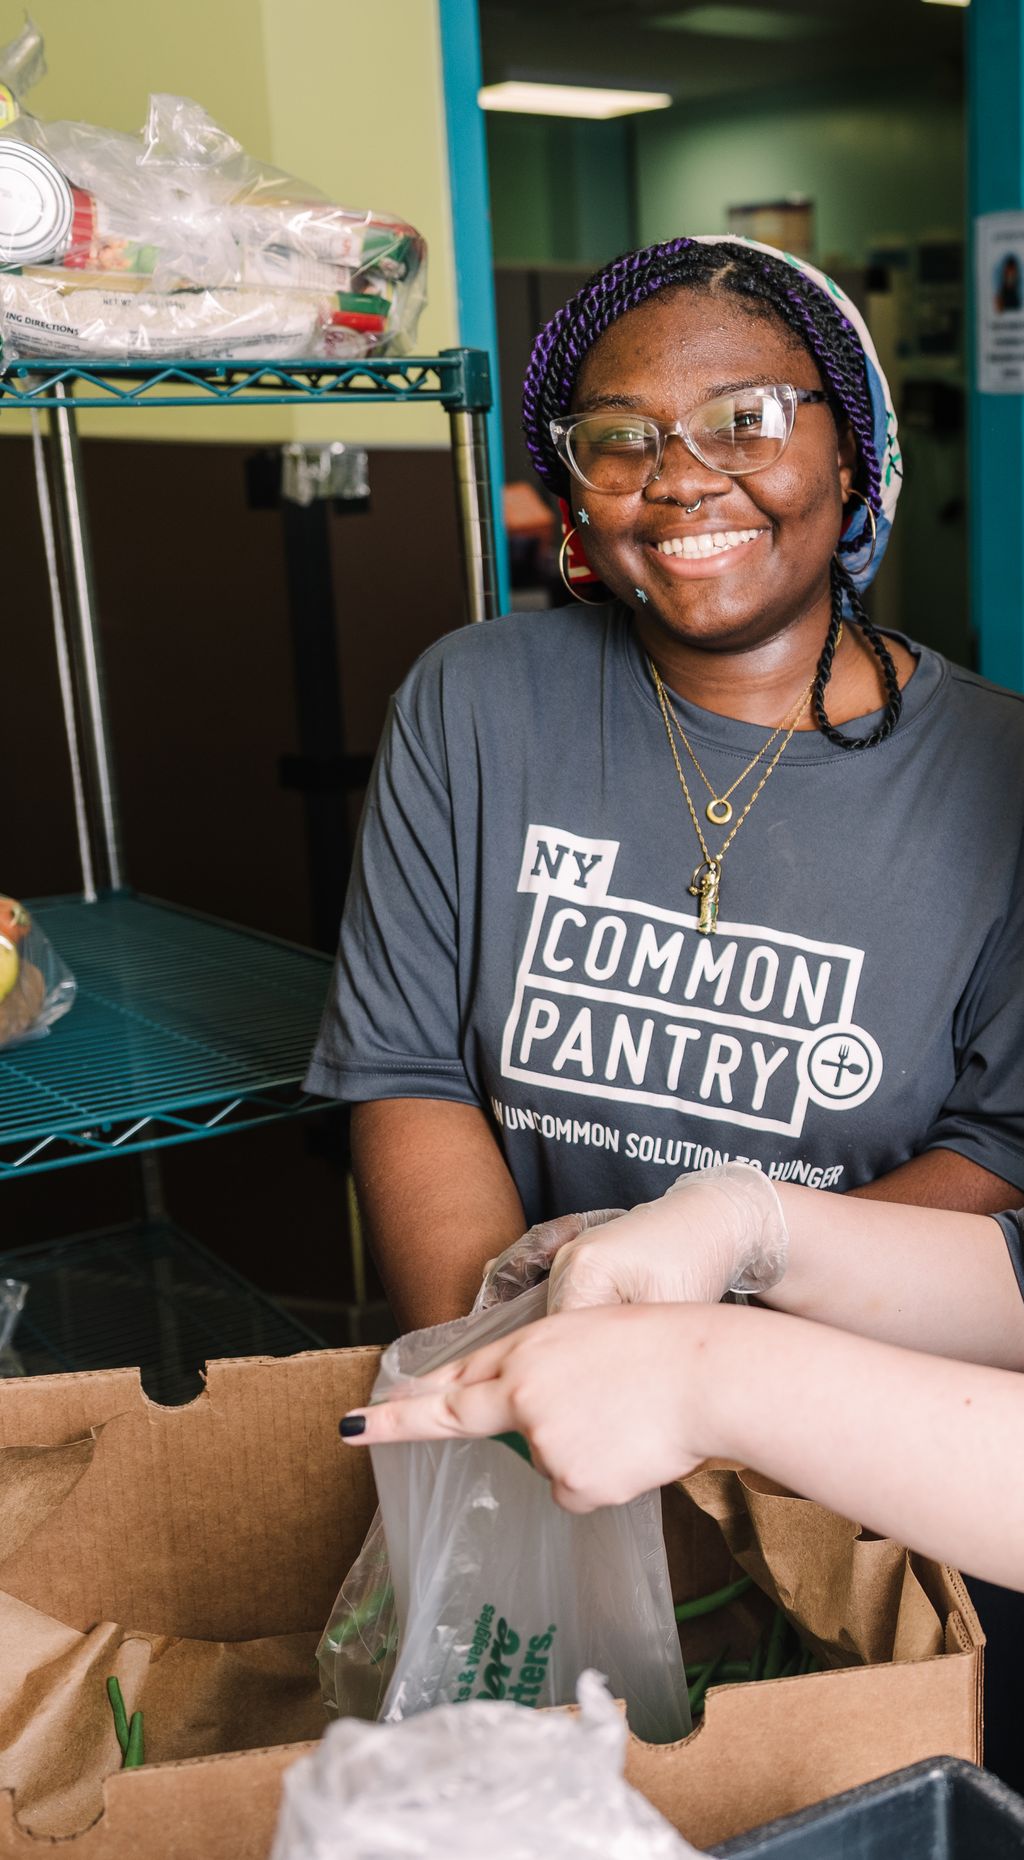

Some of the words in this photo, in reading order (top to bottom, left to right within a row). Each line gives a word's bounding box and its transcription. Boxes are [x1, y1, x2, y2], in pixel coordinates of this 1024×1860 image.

[6, 312, 23, 322] ING
[25, 317, 79, 335] DIRECTIONS
[531, 840, 603, 888] NY
[542, 908, 832, 1025] COMMON
[519, 998, 789, 1111] PANTRY
[505, 1105, 619, 1153] UNCOMMON
[625, 1133, 729, 1170] SOLUTION
[768, 1159, 844, 1188] HUNGER
[465, 1604, 496, 1665] veggies
[476, 1617, 520, 1700] ore
[507, 1623, 557, 1708] tters.
[458, 1671, 476, 1684] &
